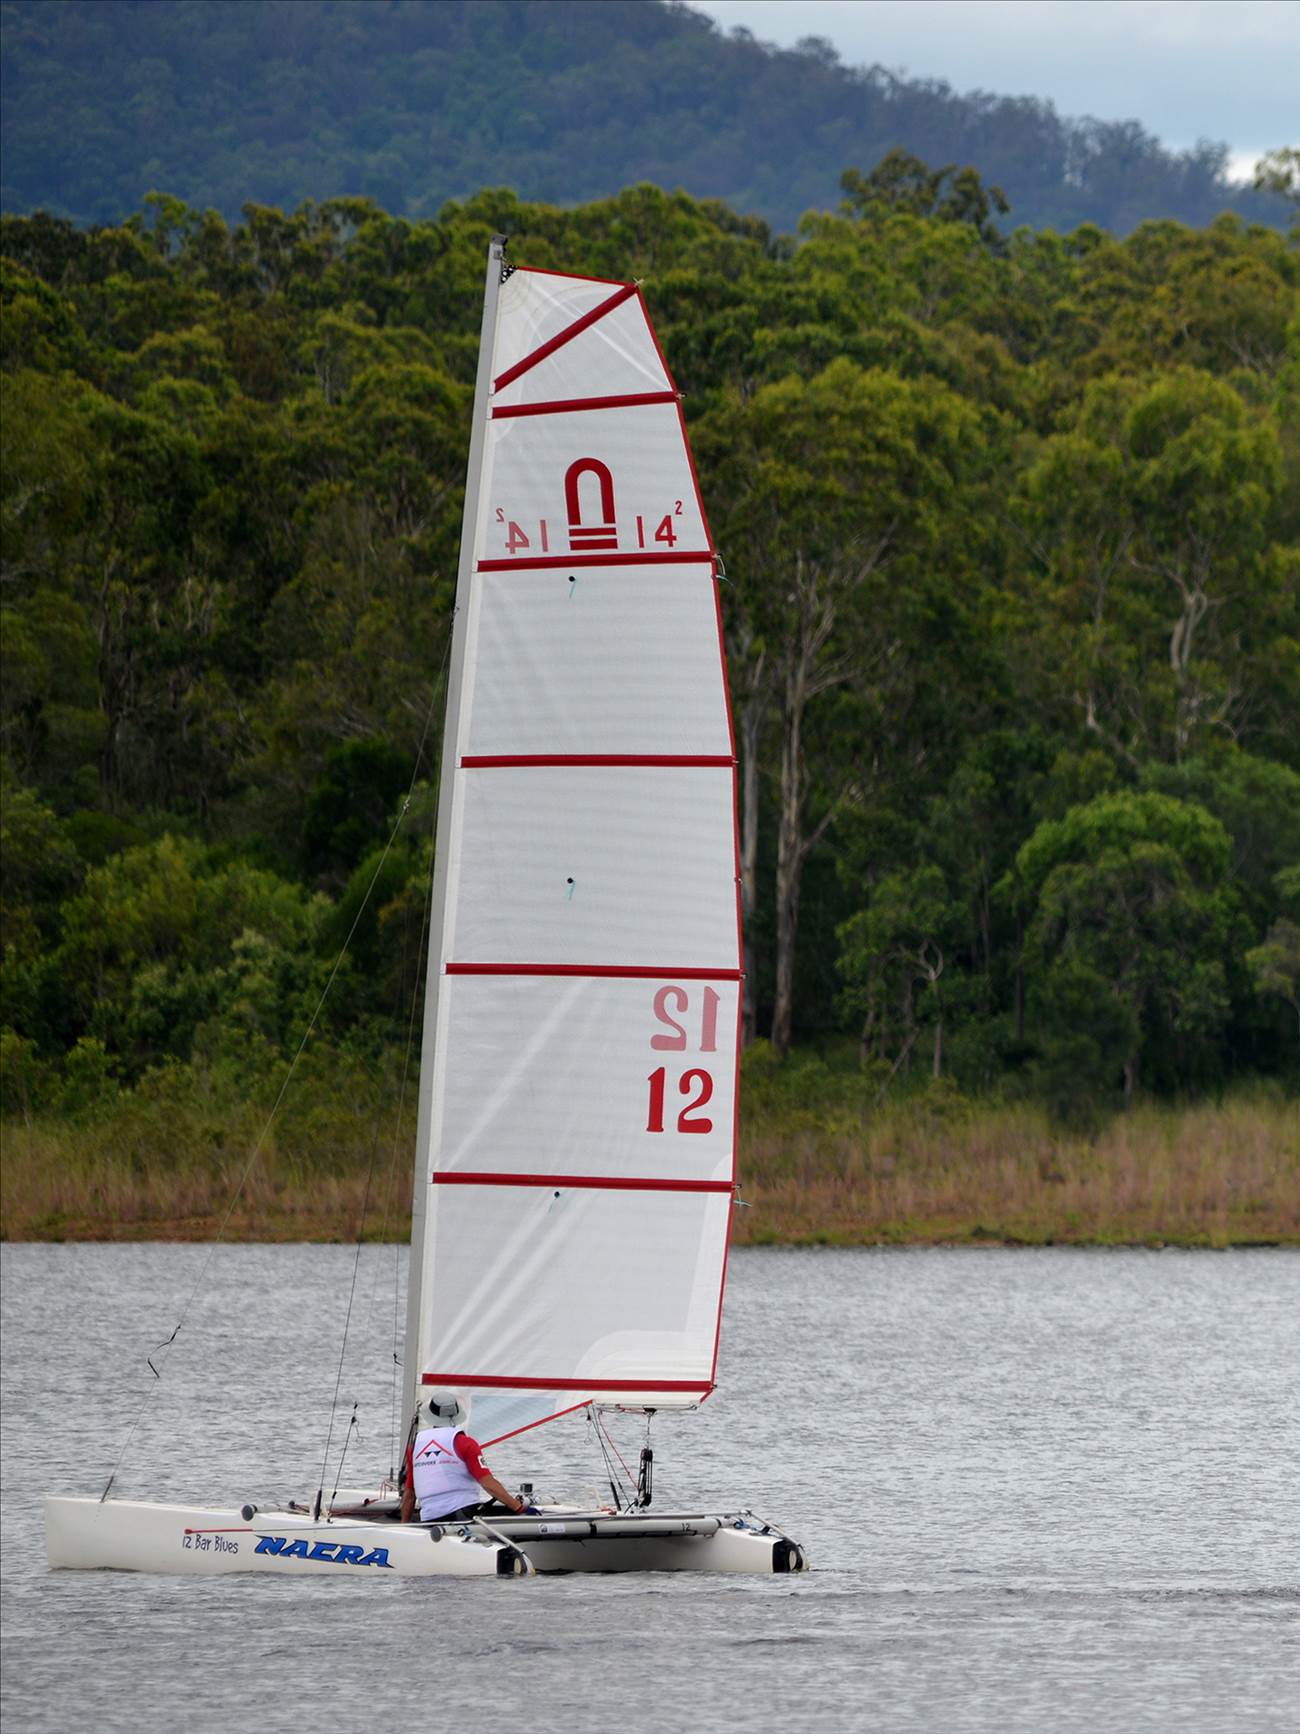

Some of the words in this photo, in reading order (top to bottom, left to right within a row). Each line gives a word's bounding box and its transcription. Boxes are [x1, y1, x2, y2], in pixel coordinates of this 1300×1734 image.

[646, 1066, 714, 1134] 12
[183, 1535, 192, 1549] 12
[195, 1534, 211, 1551] Bar
[215, 1535, 239, 1554] Blues
[253, 1535, 395, 1569] NACRA
